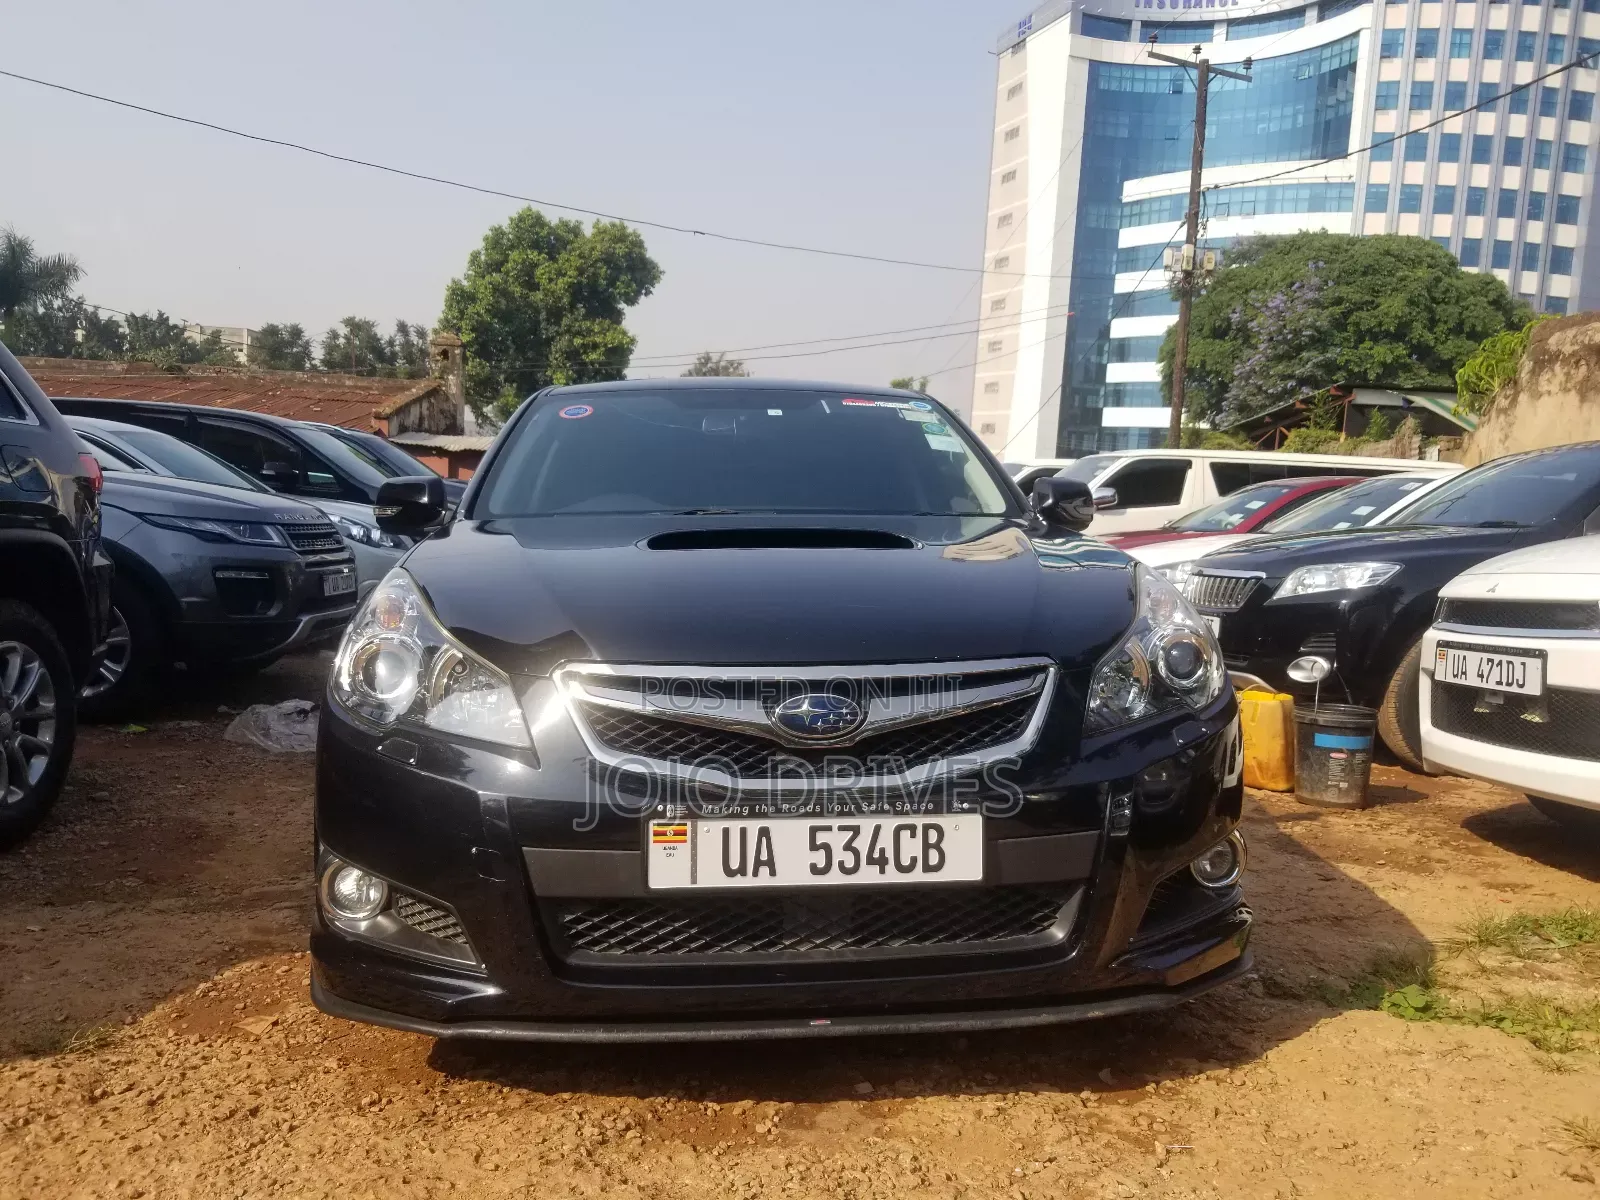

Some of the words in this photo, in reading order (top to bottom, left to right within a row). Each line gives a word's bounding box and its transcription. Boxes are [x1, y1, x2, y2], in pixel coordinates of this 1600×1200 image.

[1452, 653, 1467, 681] UA
[1476, 657, 1527, 689] 471DJ
[701, 804, 750, 816] Making
[755, 803, 776, 814] the
[782, 803, 822, 814] Roads
[827, 802, 856, 813] Your
[862, 801, 890, 812] Safe
[895, 801, 934, 813] Space
[721, 825, 777, 877] UA
[808, 822, 946, 876] 534CB
